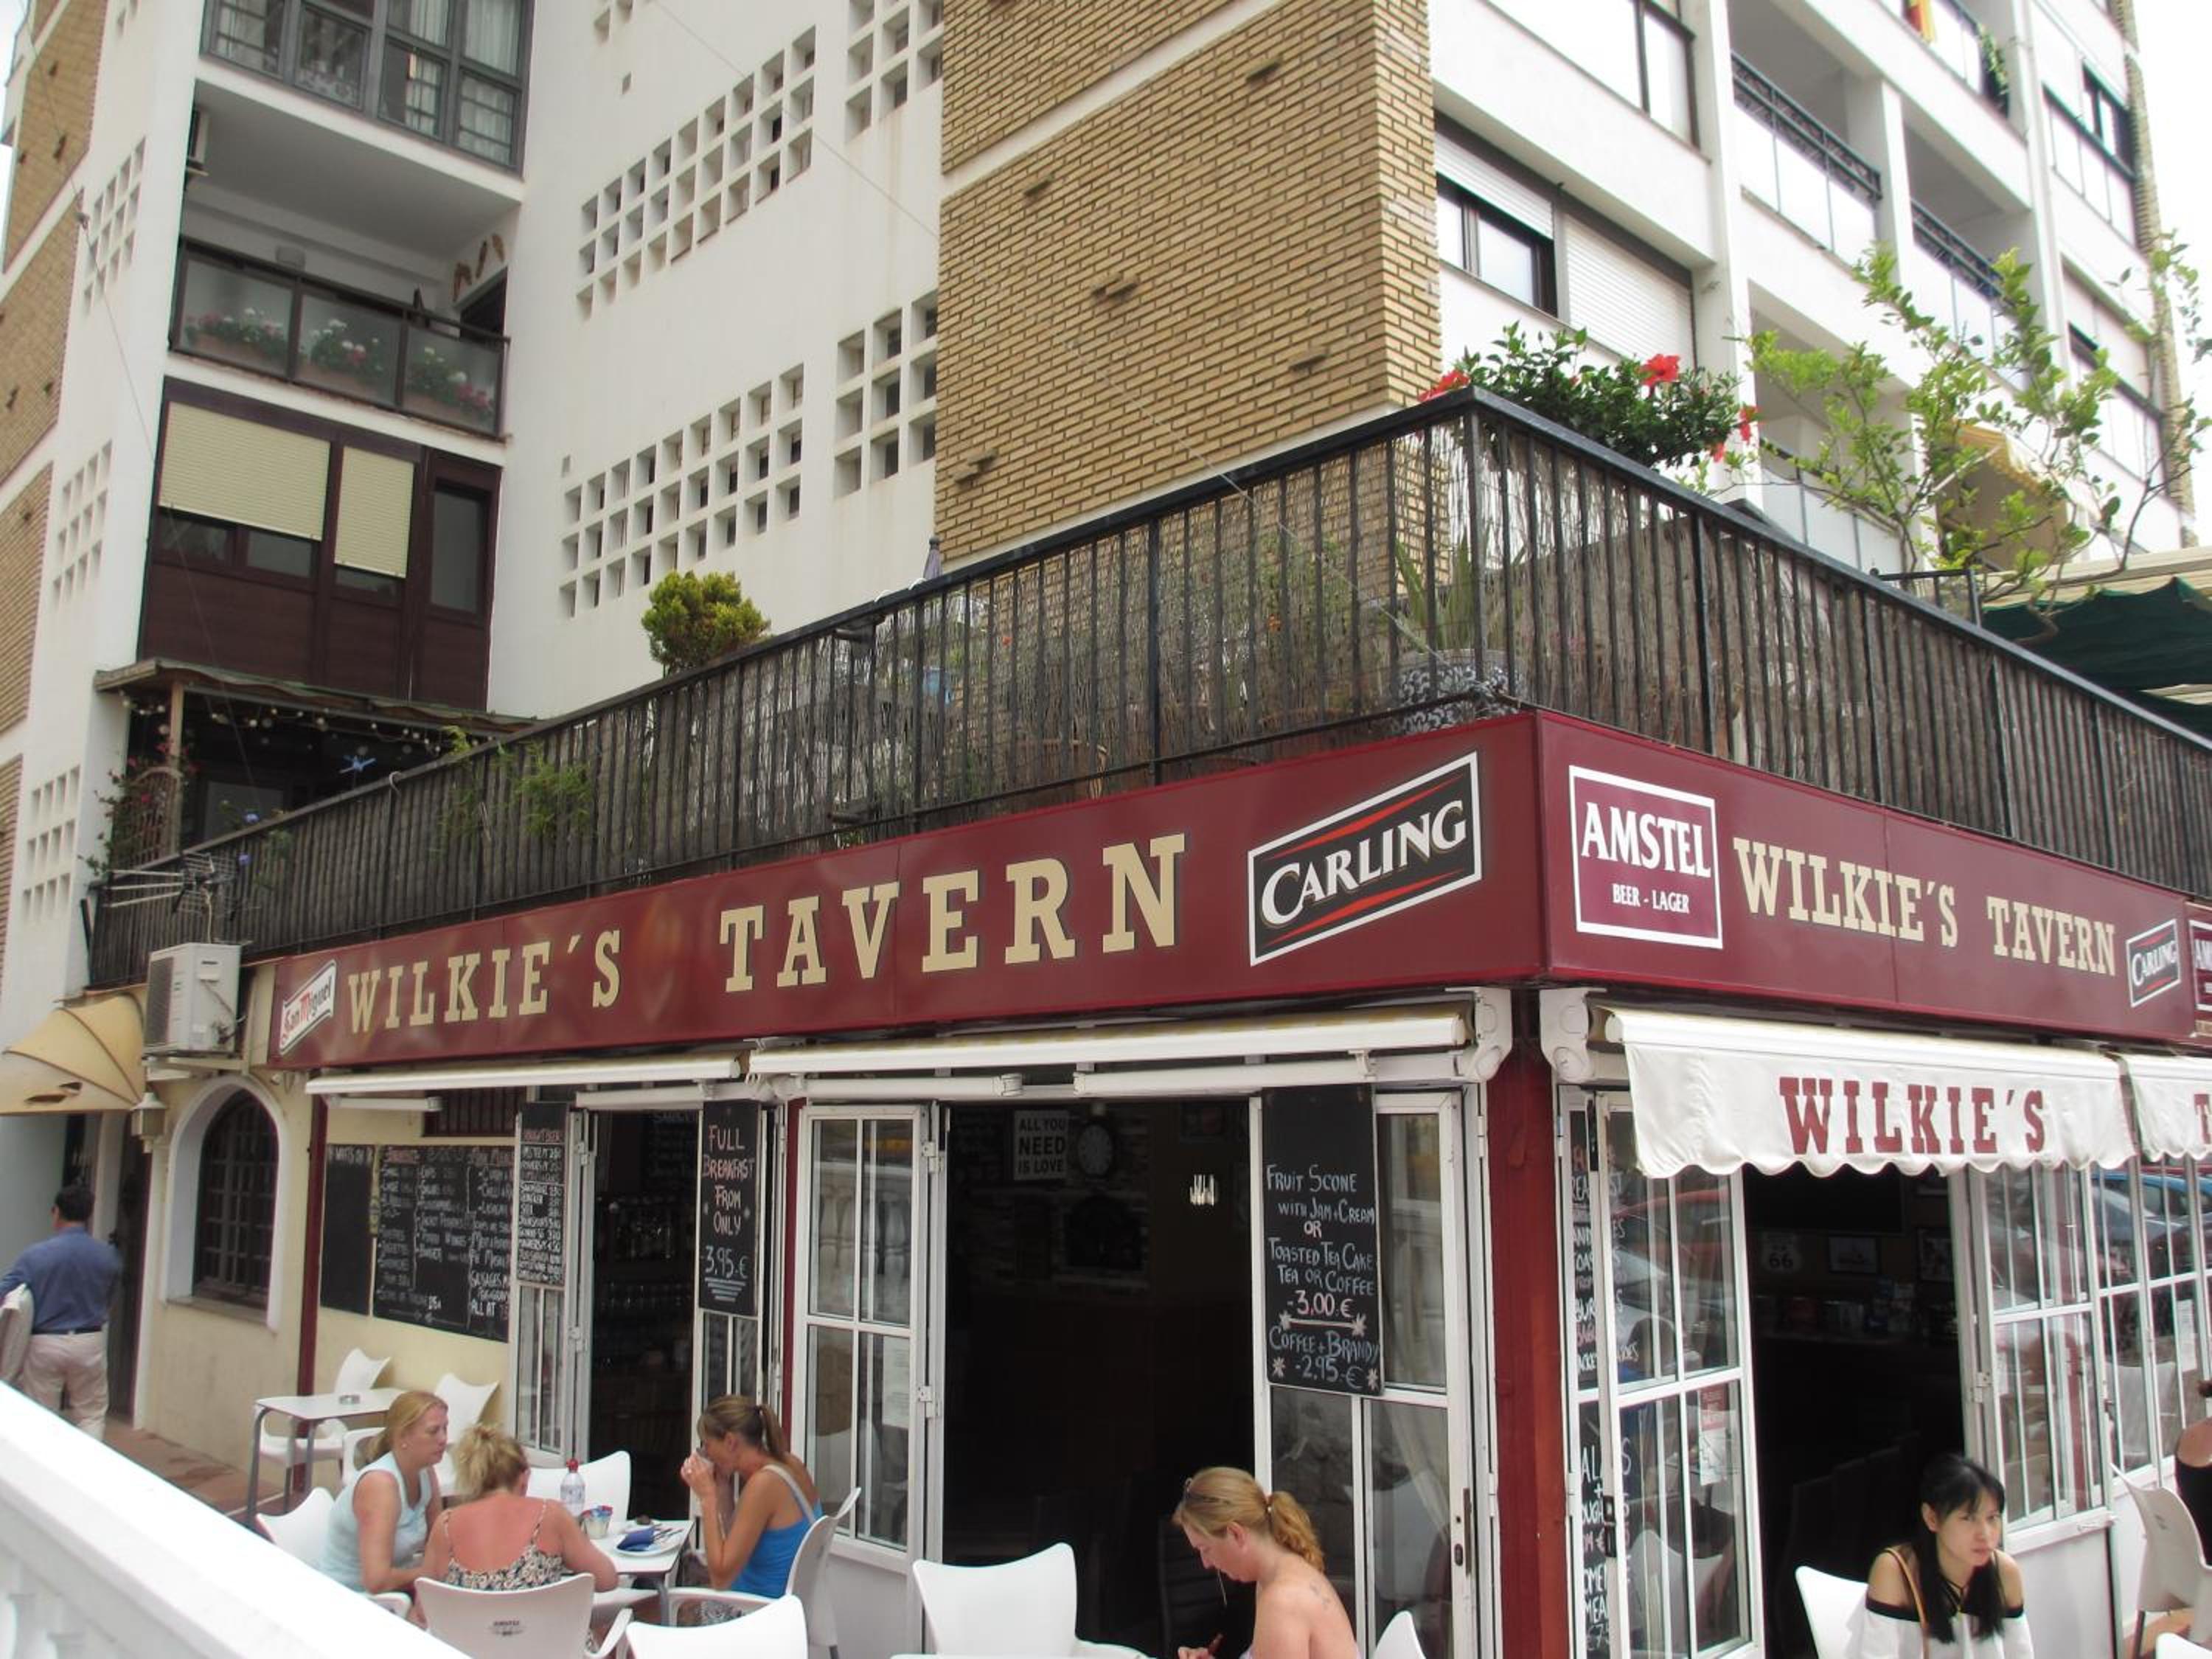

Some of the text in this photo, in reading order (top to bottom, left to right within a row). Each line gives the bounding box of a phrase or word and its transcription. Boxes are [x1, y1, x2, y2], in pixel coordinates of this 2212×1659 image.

[1581, 801, 1711, 877] AMSTEL
[1262, 800, 1467, 925] CARLING
[719, 833, 1186, 992] TAVERN
[1613, 883, 1641, 907] BEER
[1652, 889, 1690, 914] LAGER
[1986, 896, 2116, 976] TAVERN
[708, 1124, 745, 1152] FULL
[1019, 1118, 1067, 1131] ALL YOU
[1018, 1136, 1066, 1155] NEED
[703, 1154, 755, 1181] BREAKFAST
[1018, 1158, 1064, 1174] IS LOVE
[1309, 1164, 1357, 1192] SCONE
[714, 1185, 741, 1211] FROM
[713, 1213, 741, 1236] ONLY
[1304, 1220, 1322, 1238] OR
[1268, 1237, 1374, 1273] TOASTED TEA CAKE
[1769, 1252, 1794, 1270] 66
[1277, 1265, 1374, 1296] TEA OR COFFEE
[1269, 1325, 1316, 1354] COFFEE
[1325, 1330, 1381, 1364] BRANDY
